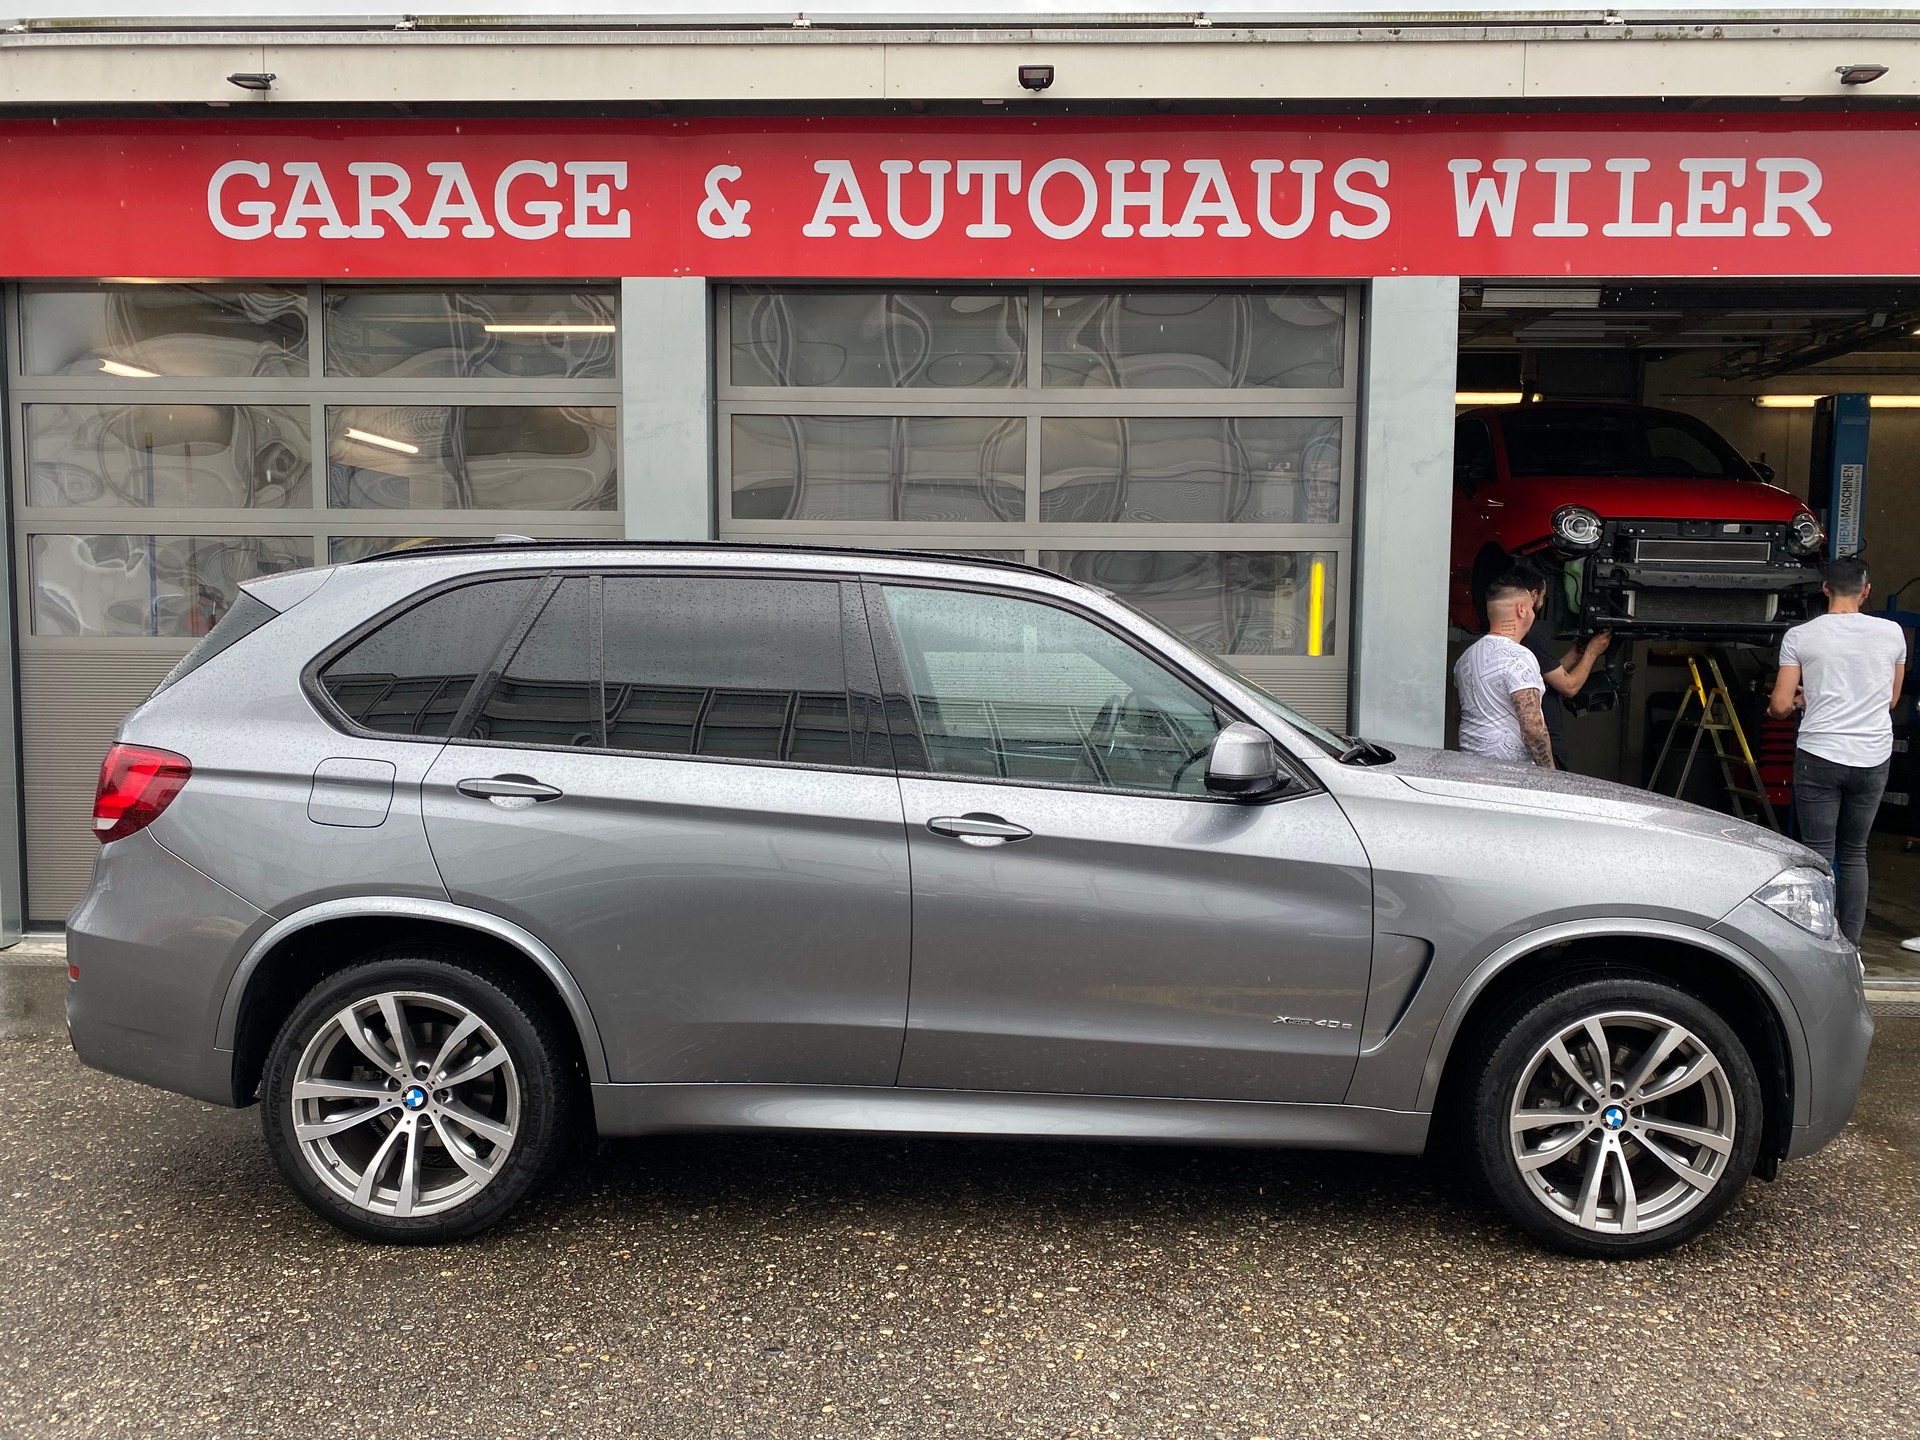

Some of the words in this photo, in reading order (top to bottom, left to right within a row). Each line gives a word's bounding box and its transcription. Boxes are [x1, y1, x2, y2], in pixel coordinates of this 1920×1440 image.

[207, 160, 631, 241] GARAGE
[696, 164, 752, 240] &
[802, 158, 1391, 241] AUTOHAUS
[1447, 157, 1832, 239] WILER
[1839, 466, 1855, 543] REMAMASCHINEN
[1697, 574, 1734, 583] ABARTH
